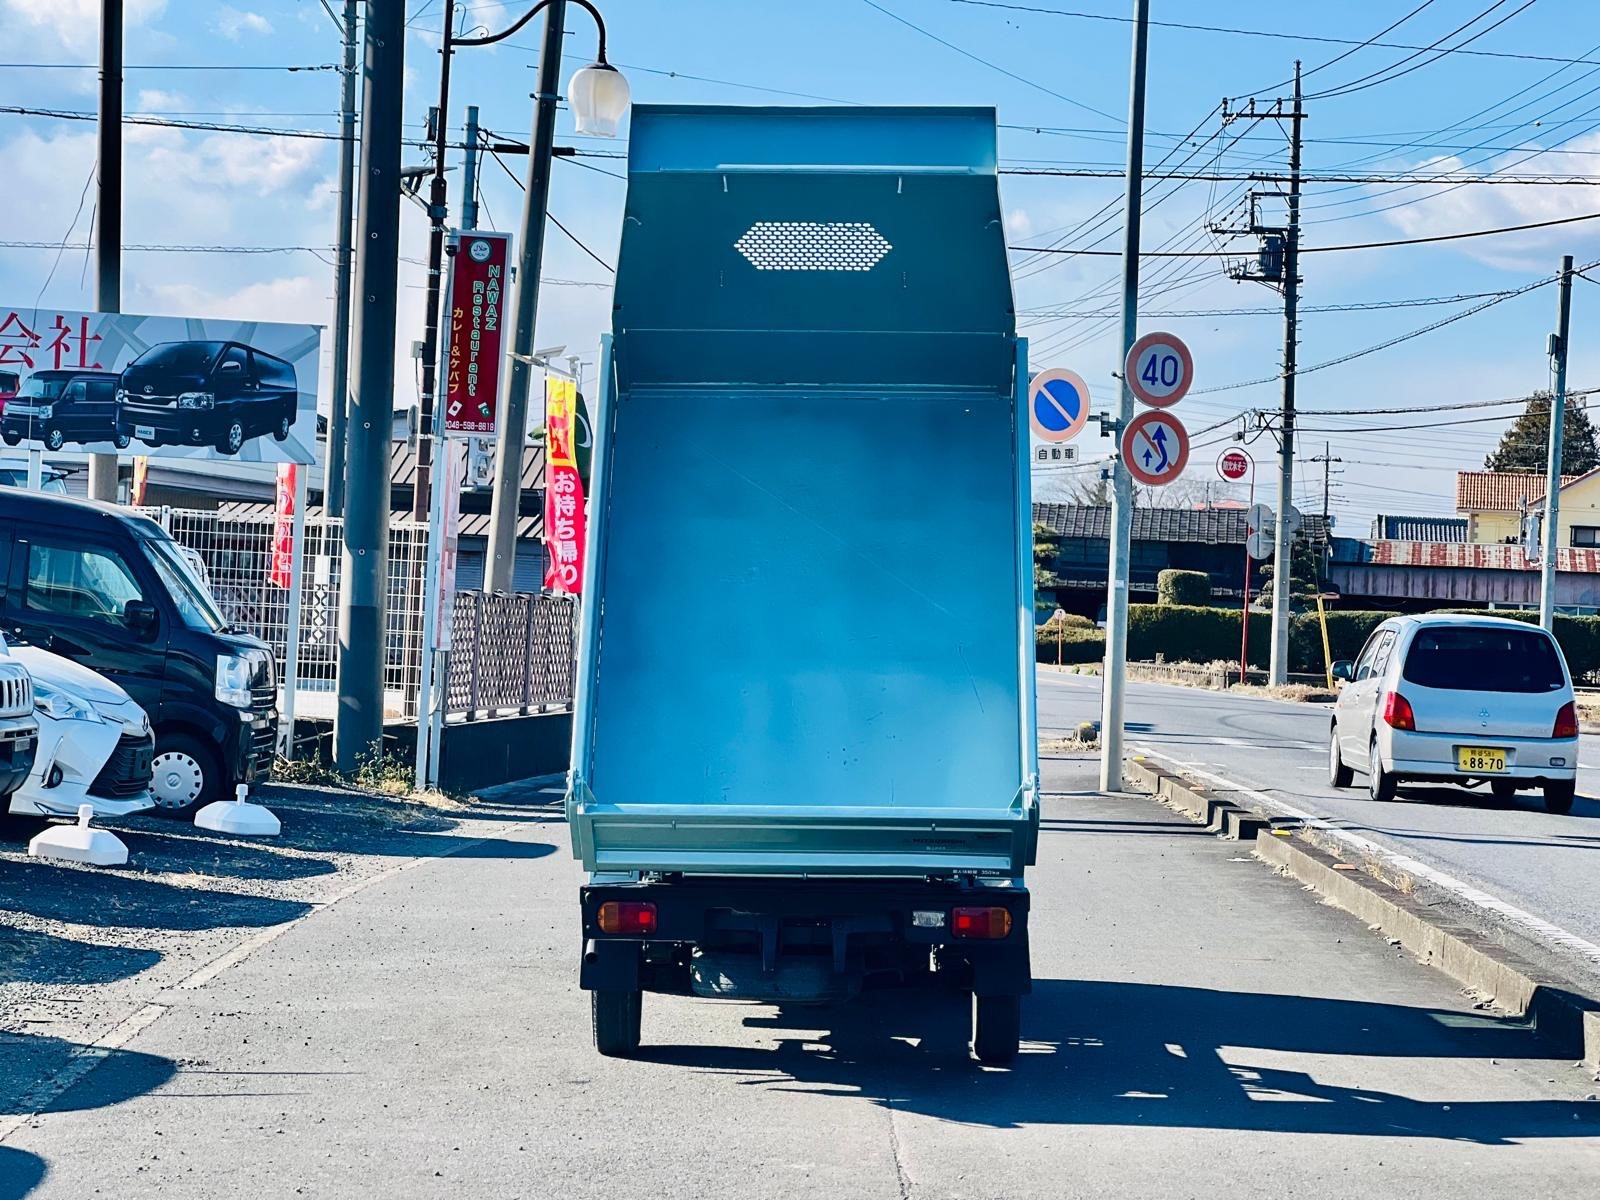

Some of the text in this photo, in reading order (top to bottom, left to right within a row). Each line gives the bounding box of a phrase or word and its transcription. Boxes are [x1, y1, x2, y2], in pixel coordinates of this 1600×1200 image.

[485, 265, 500, 331] NAWAZ
[0, 312, 103, 369] 会社
[468, 281, 484, 397] Restaurant
[1141, 353, 1179, 387] 40
[1038, 448, 1075, 460] 自動車
[554, 471, 578, 585] お持ち帰り
[1470, 757, 1503, 770] 88-70
